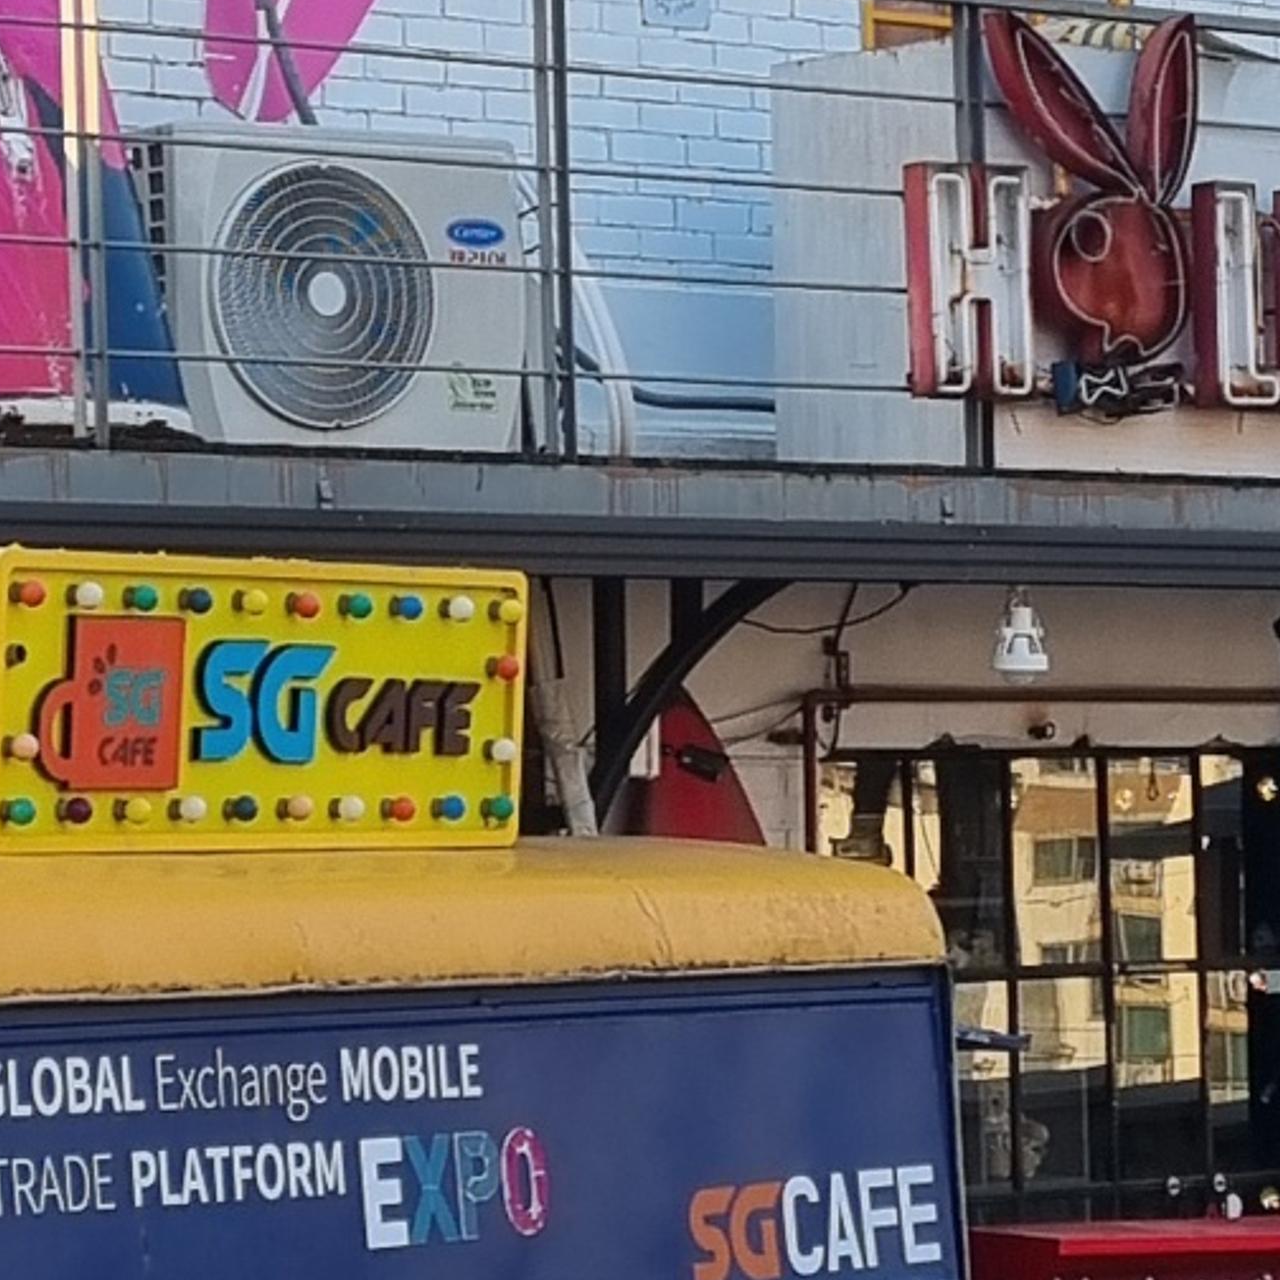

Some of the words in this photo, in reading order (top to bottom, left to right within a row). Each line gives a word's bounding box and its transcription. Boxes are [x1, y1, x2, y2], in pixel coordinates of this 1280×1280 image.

[104, 667, 166, 726] SG
[190, 639, 336, 764] SG
[325, 677, 482, 756] CAFE
[97, 735, 158, 767] CAFE
[155, 1046, 328, 1122] Exchange
[339, 1043, 483, 1102] MOBILE
[131, 1140, 347, 1208] PLATFORM
[359, 1125, 551, 1251] EXPO
